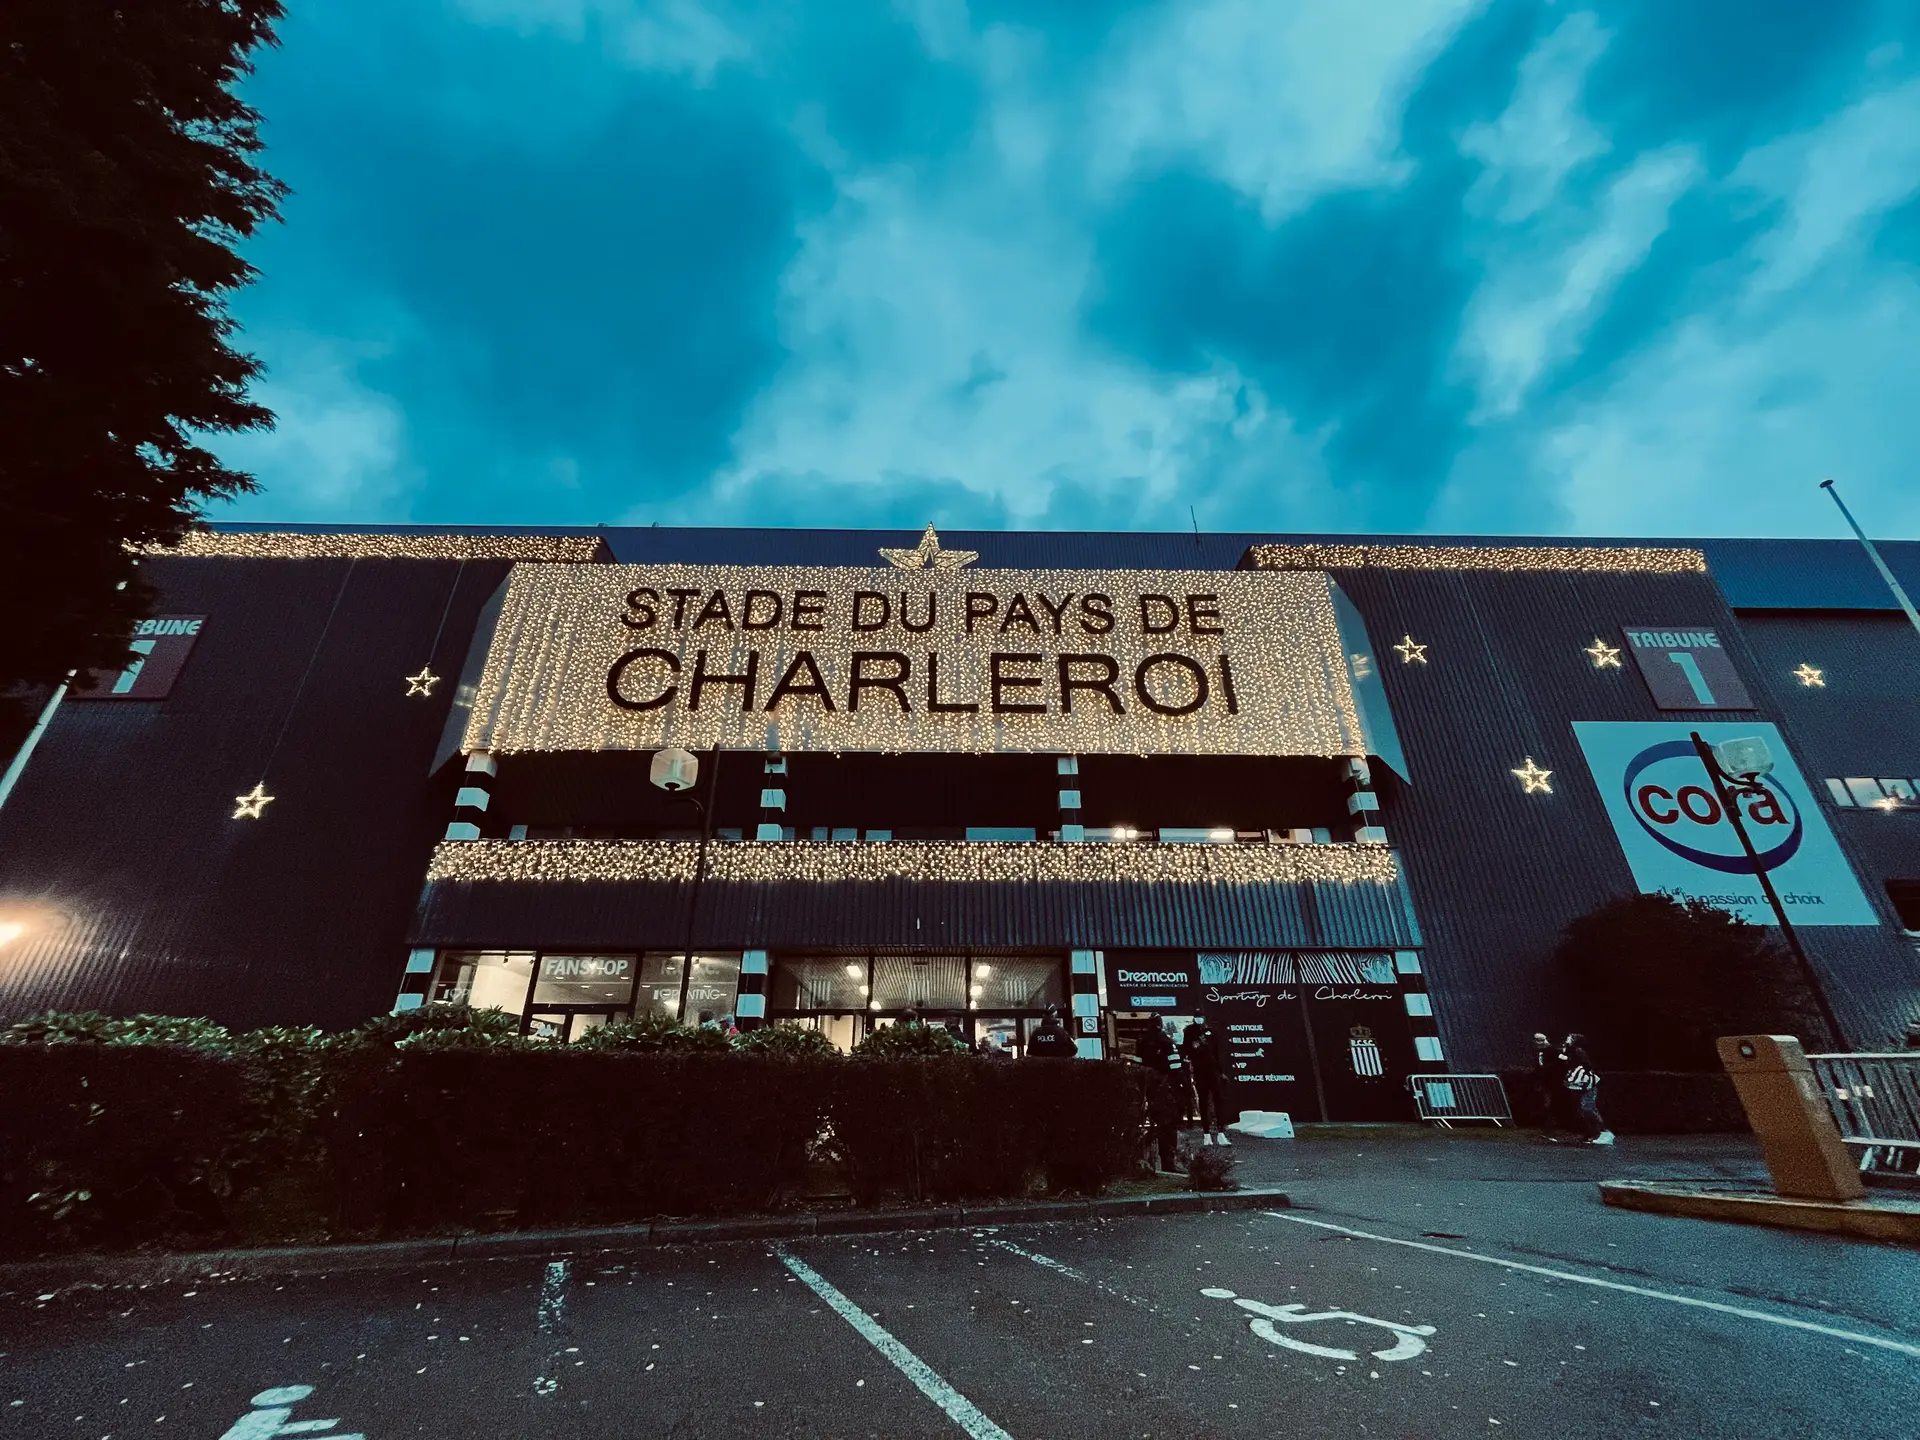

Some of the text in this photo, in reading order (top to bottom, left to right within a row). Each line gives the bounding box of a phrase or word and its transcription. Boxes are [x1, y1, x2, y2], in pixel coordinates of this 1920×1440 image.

[619, 587, 1225, 635] STADE DU PAYS DE
[132, 619, 202, 636] BUNE
[1625, 630, 1720, 649] TRIBUNE
[605, 647, 1240, 717] CHARLEROI
[1667, 652, 1716, 705] 1
[1701, 892, 1757, 907] passion
[1784, 892, 1825, 904] choix
[545, 959, 628, 975] FANSHOP
[671, 988, 720, 1000] PNTING
[1206, 986, 1393, 1008] Sporting de Charleroi
[1230, 1024, 1264, 1032] BOUTIQUE
[1238, 1074, 1264, 1082] ESPACE
